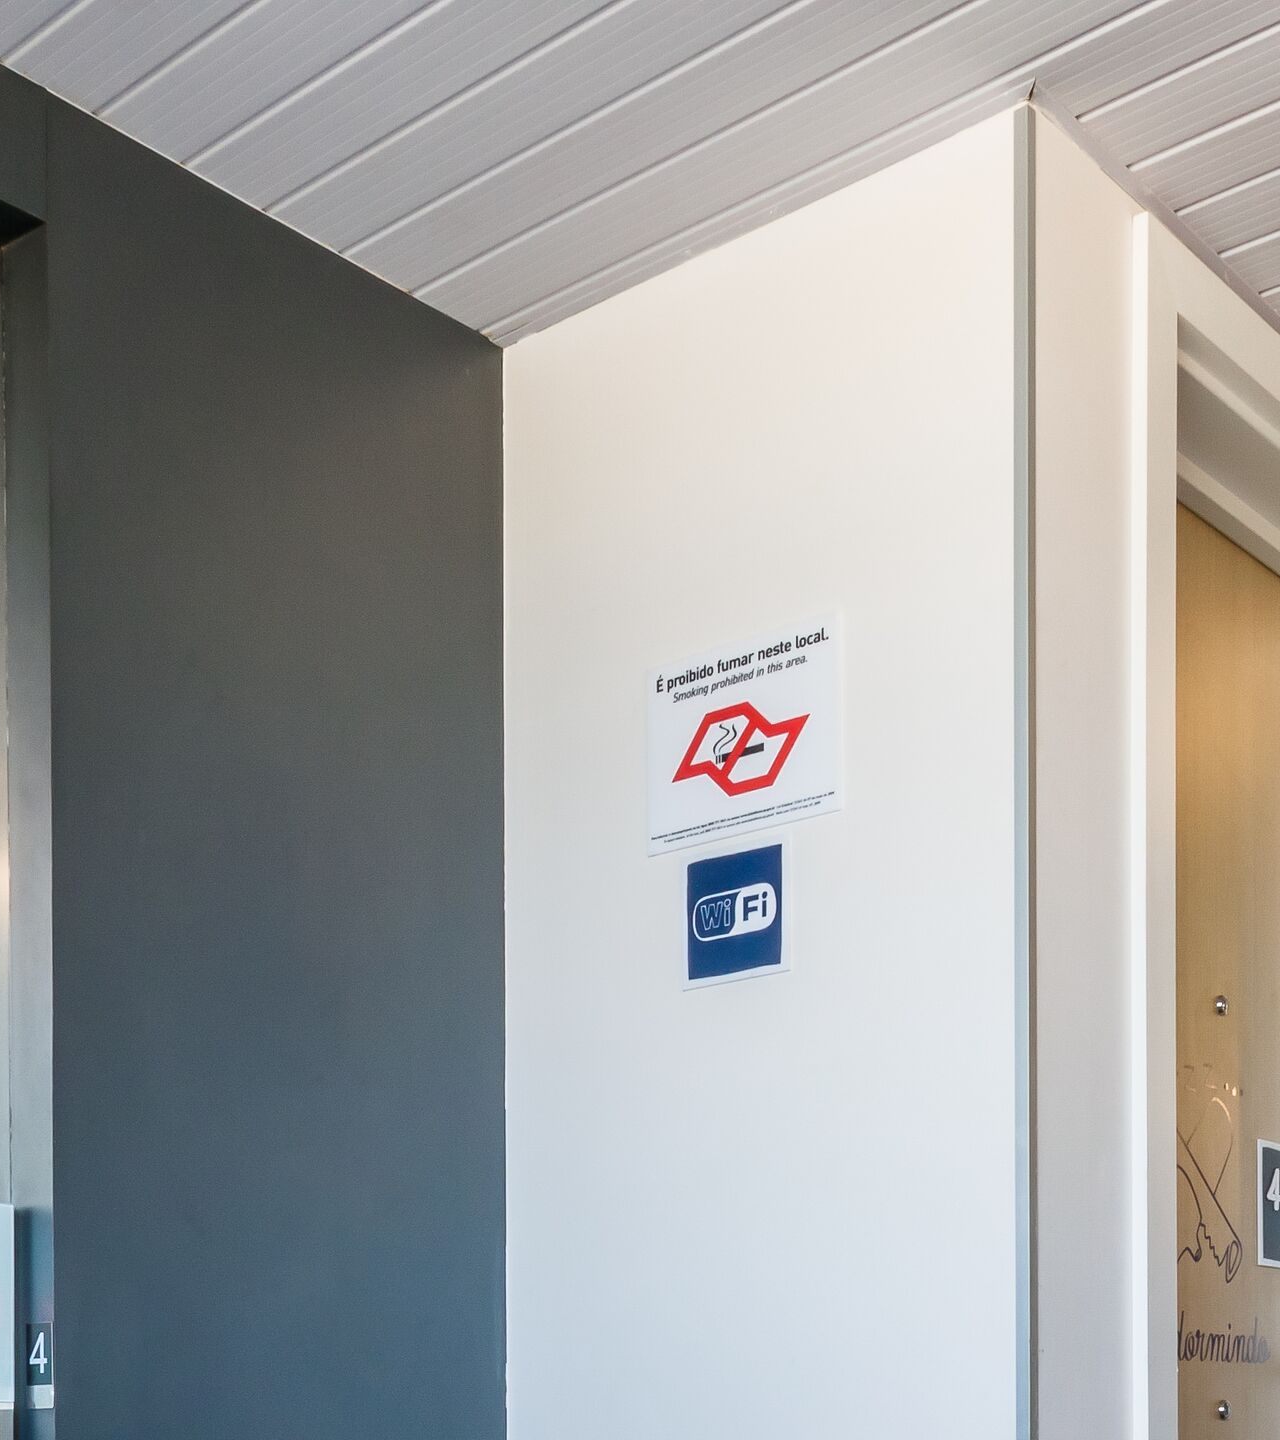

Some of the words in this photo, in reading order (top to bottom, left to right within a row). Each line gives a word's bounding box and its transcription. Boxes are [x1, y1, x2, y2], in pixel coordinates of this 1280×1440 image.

[656, 674, 664, 693] É
[666, 664, 714, 693] proibido
[717, 653, 754, 674] fumar
[758, 641, 792, 661] neste
[795, 627, 829, 649] local.
[673, 685, 709, 703] Smoking
[711, 668, 754, 694] prohibited
[756, 666, 765, 677] in
[767, 662, 783, 674] this
[785, 655, 808, 669] area.
[29, 1331, 48, 1374] 4
